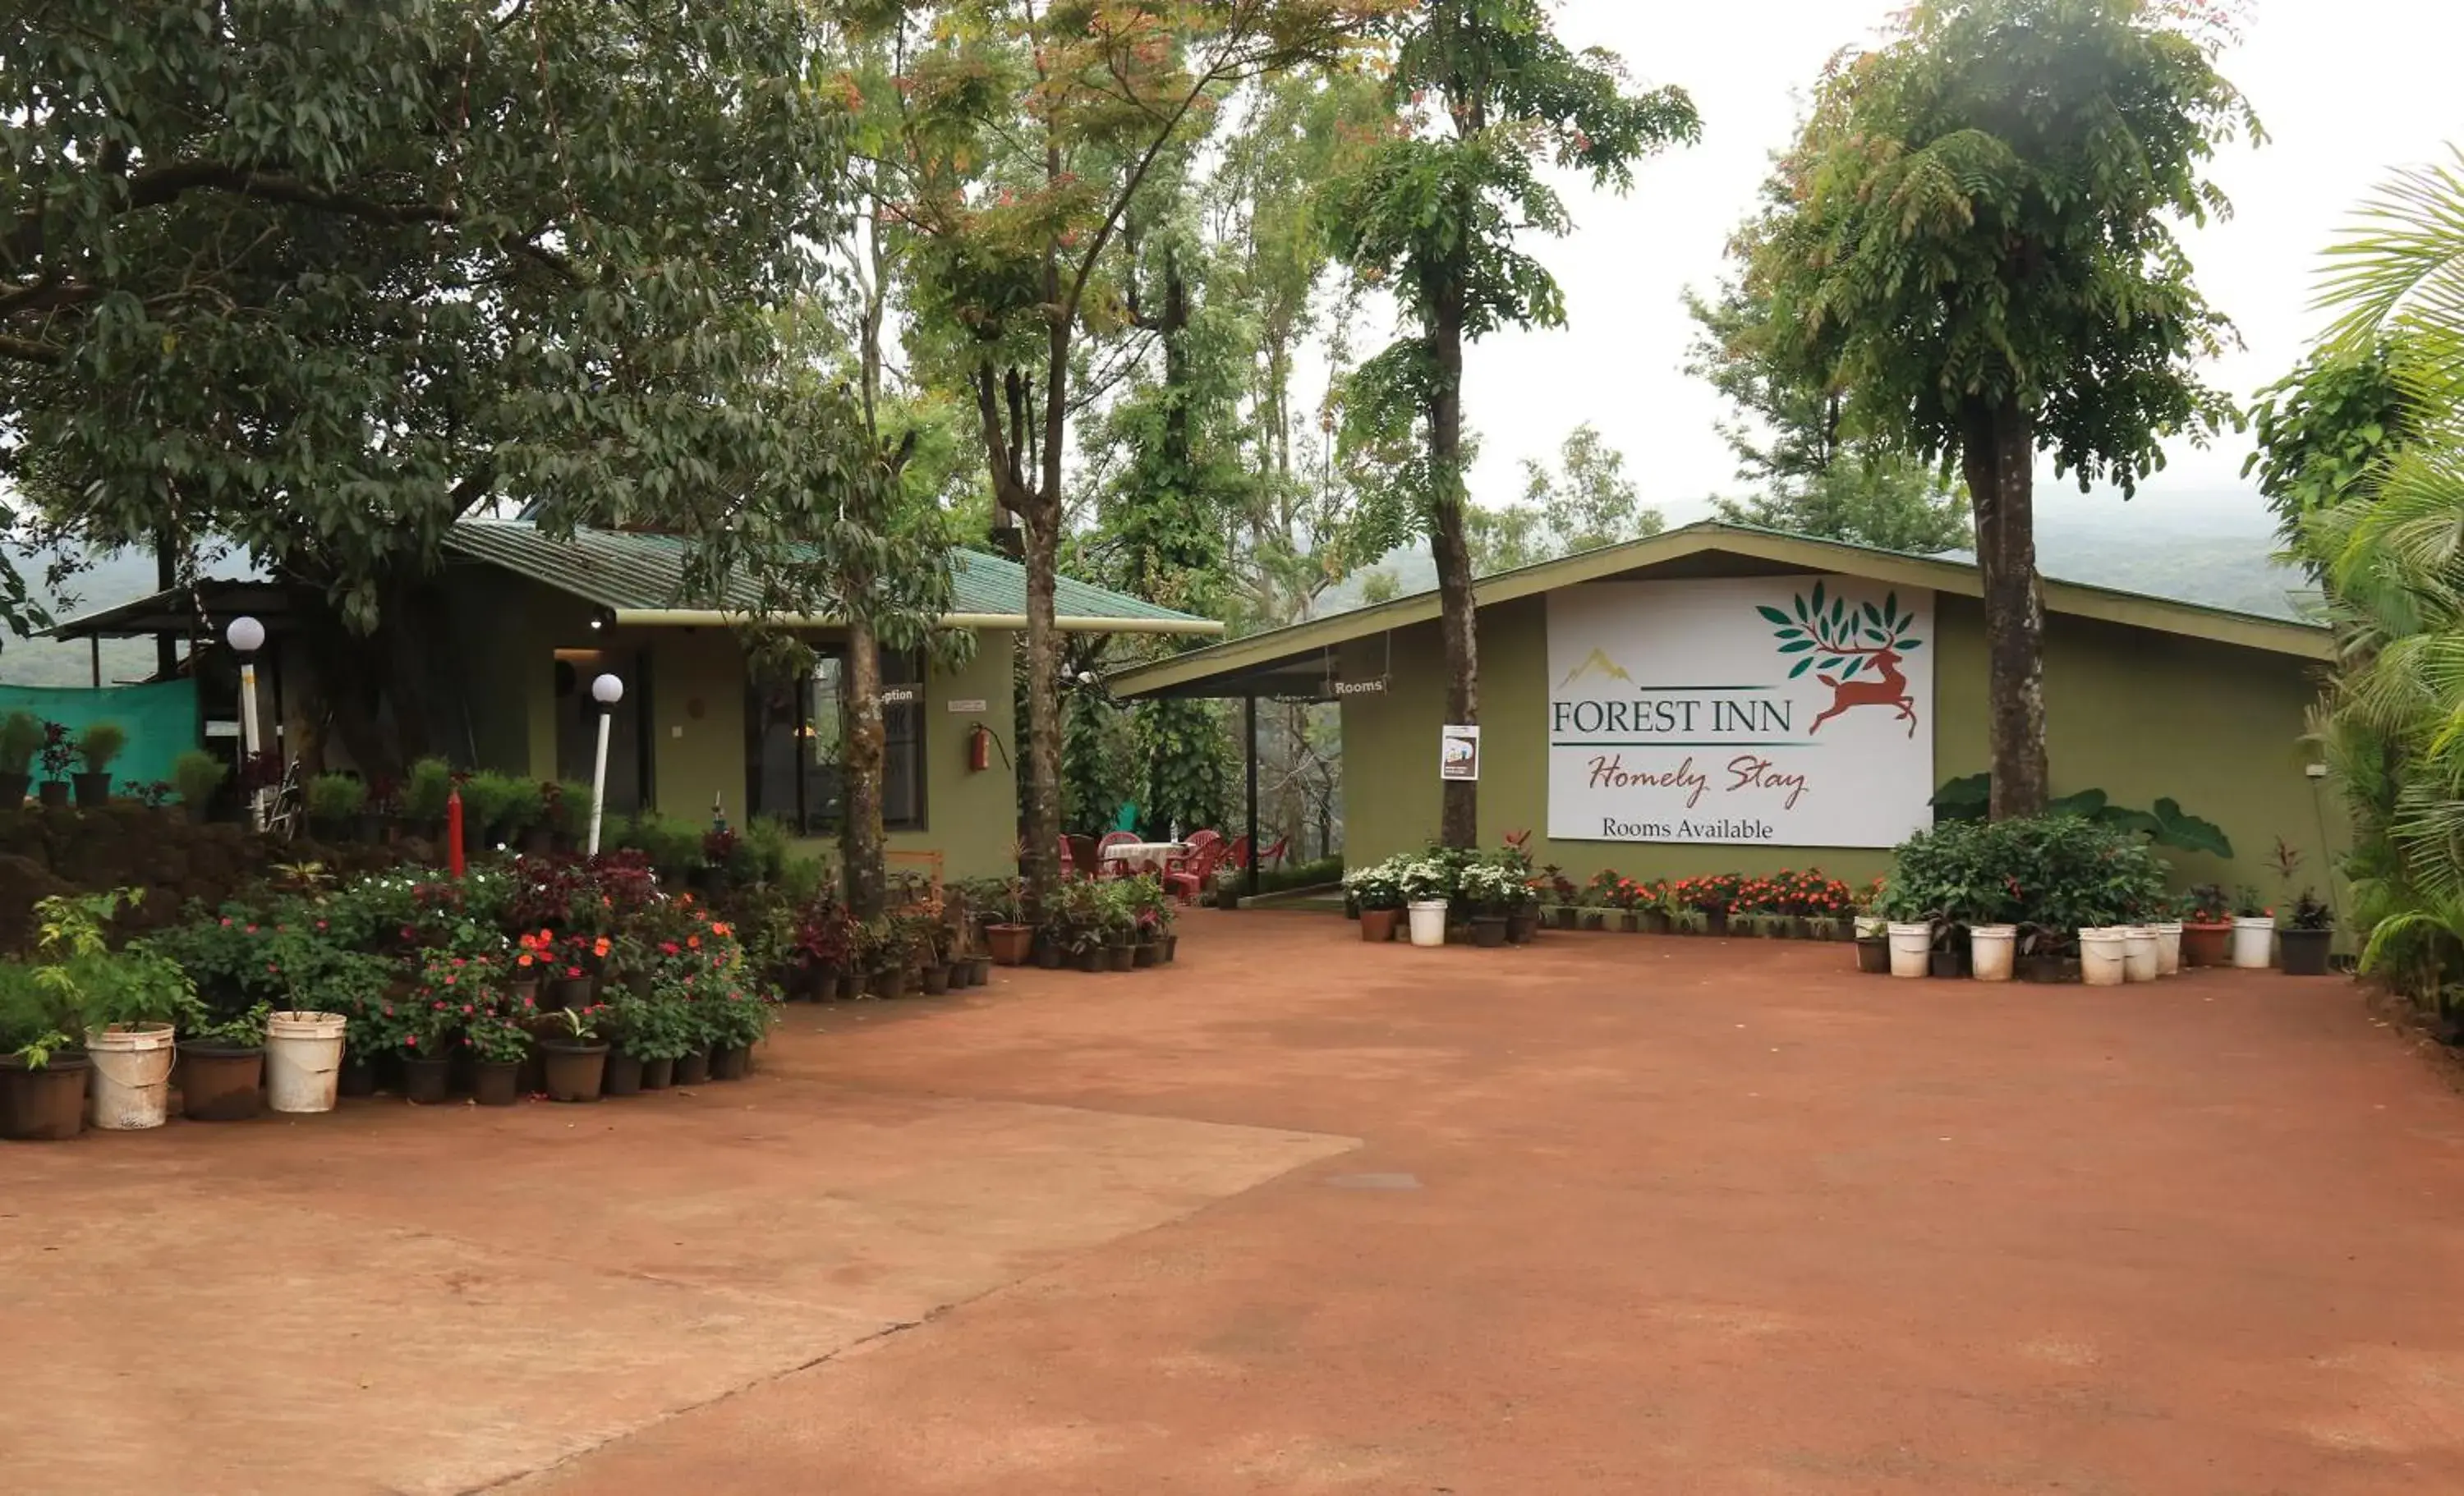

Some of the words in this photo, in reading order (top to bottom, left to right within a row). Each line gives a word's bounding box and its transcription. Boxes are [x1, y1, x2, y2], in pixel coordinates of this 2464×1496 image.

[1335, 681, 1382, 694] Rooms
[1552, 700, 1700, 733] FOREST
[1711, 700, 1793, 732] INN
[1588, 754, 1710, 809] Homely
[1726, 755, 1809, 810] Stay
[1602, 818, 1671, 838] Rooms
[1678, 819, 1773, 839] Available
